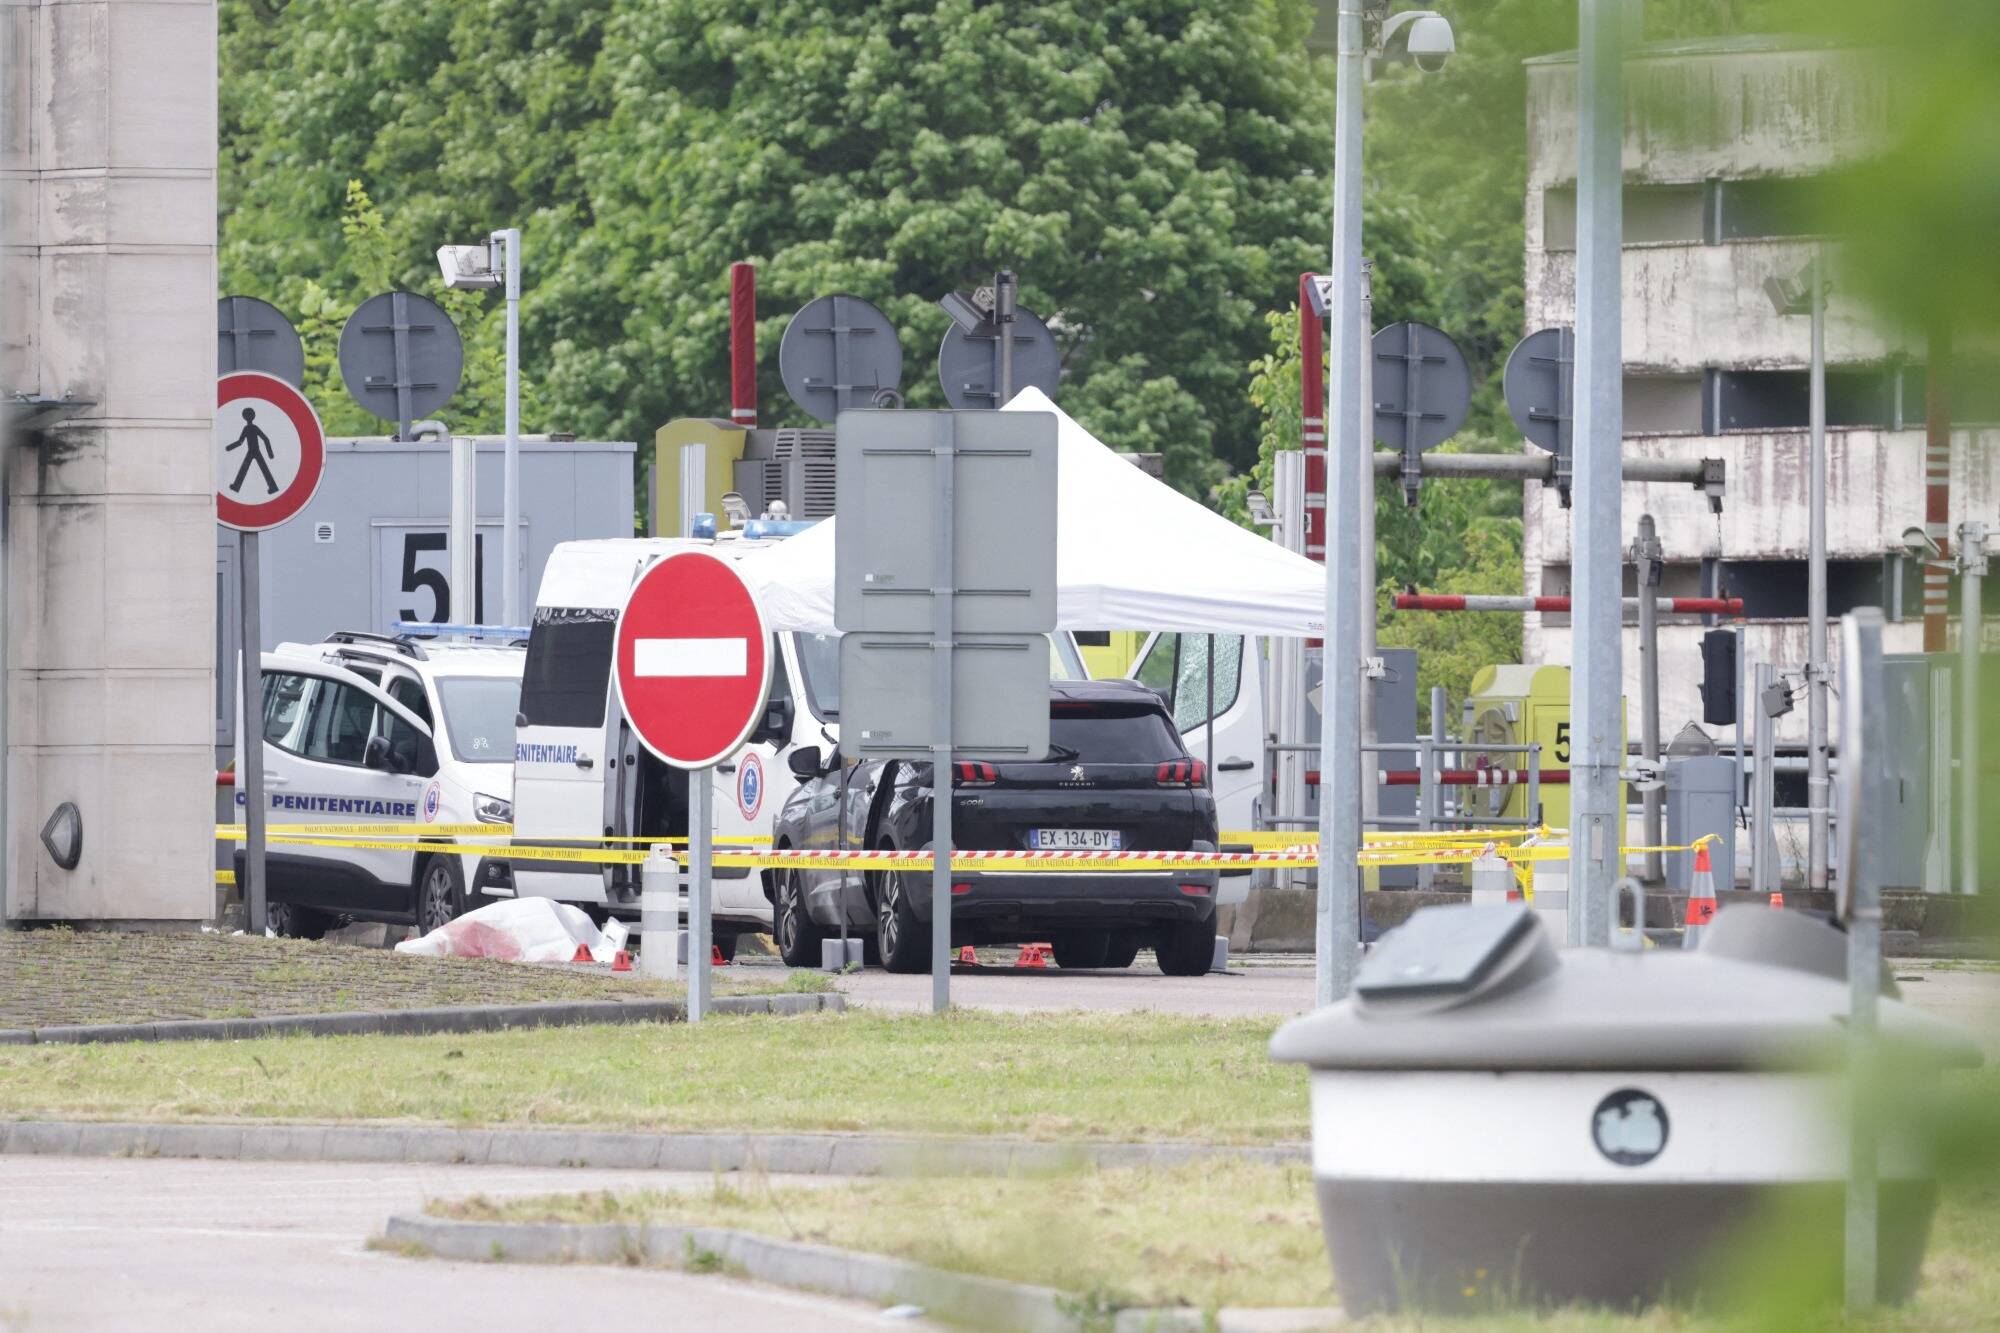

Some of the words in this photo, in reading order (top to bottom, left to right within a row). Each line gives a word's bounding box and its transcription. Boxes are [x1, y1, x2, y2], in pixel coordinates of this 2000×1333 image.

[515, 743, 577, 763] ENITENTIAIRE
[271, 794, 416, 817] PENITENTIAIRE
[1040, 830, 1110, 847] EX-134-DY
